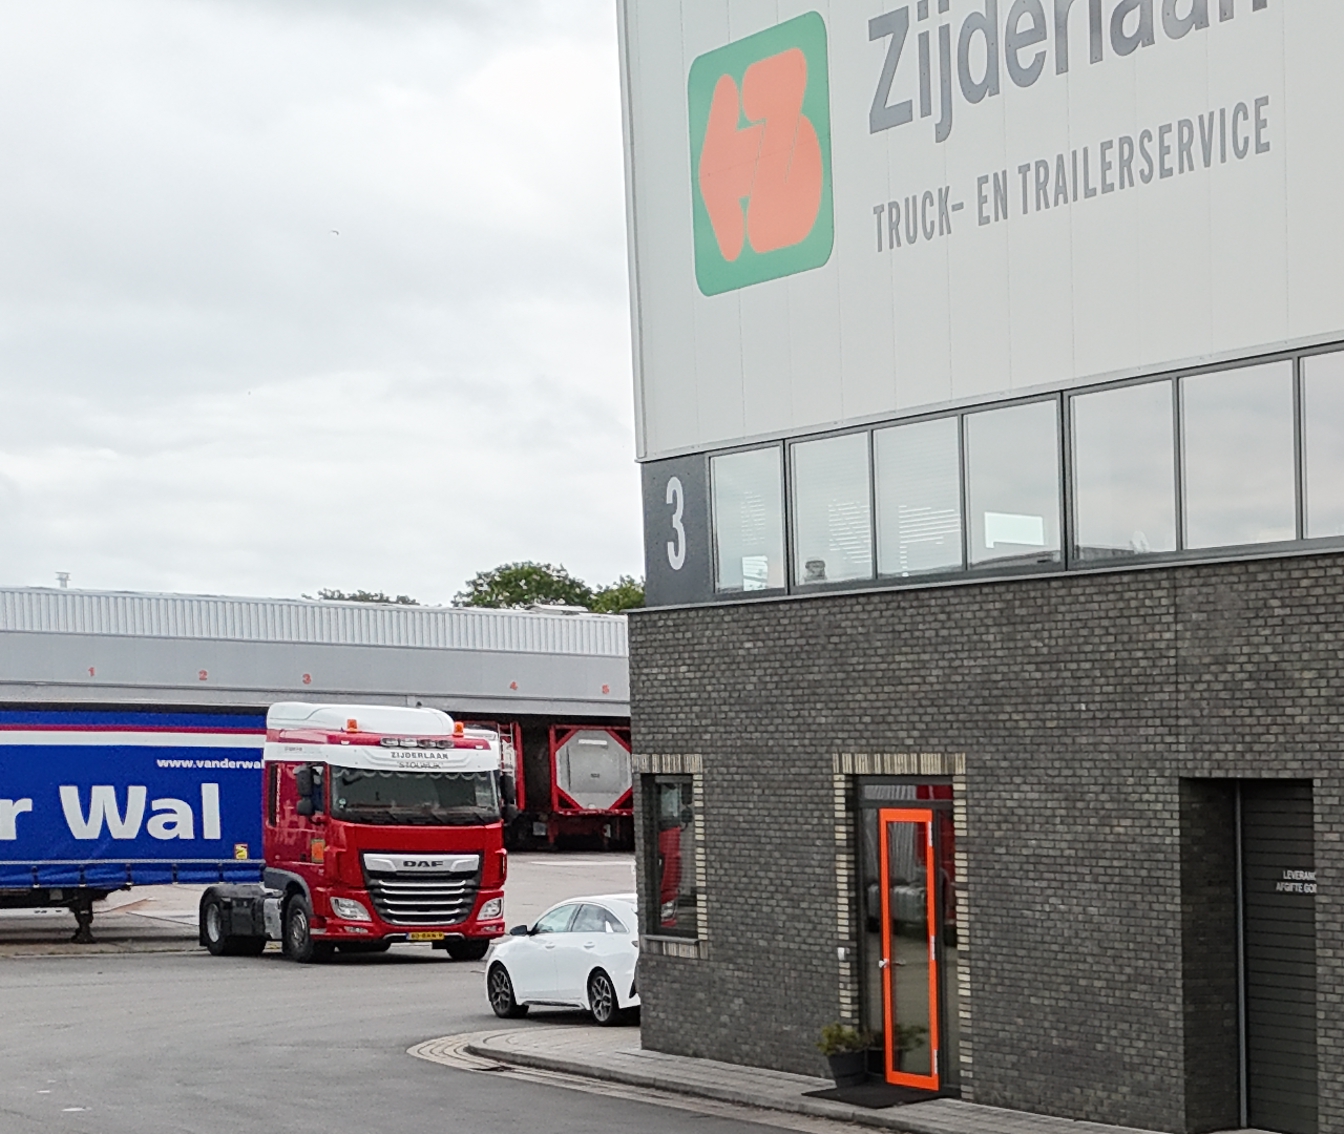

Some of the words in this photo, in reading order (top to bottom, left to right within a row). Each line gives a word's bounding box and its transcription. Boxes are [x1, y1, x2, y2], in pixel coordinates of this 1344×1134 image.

[873, 185, 964, 252] TRUCK-
[977, 170, 1008, 226] EN
[1018, 95, 1271, 215] TRAILERSERVICE
[666, 476, 686, 570] 3
[88, 667, 95, 677] 1
[199, 670, 208, 681] 2
[302, 673, 311, 684] 3
[510, 681, 518, 691] 4
[59, 783, 222, 840] Wal
